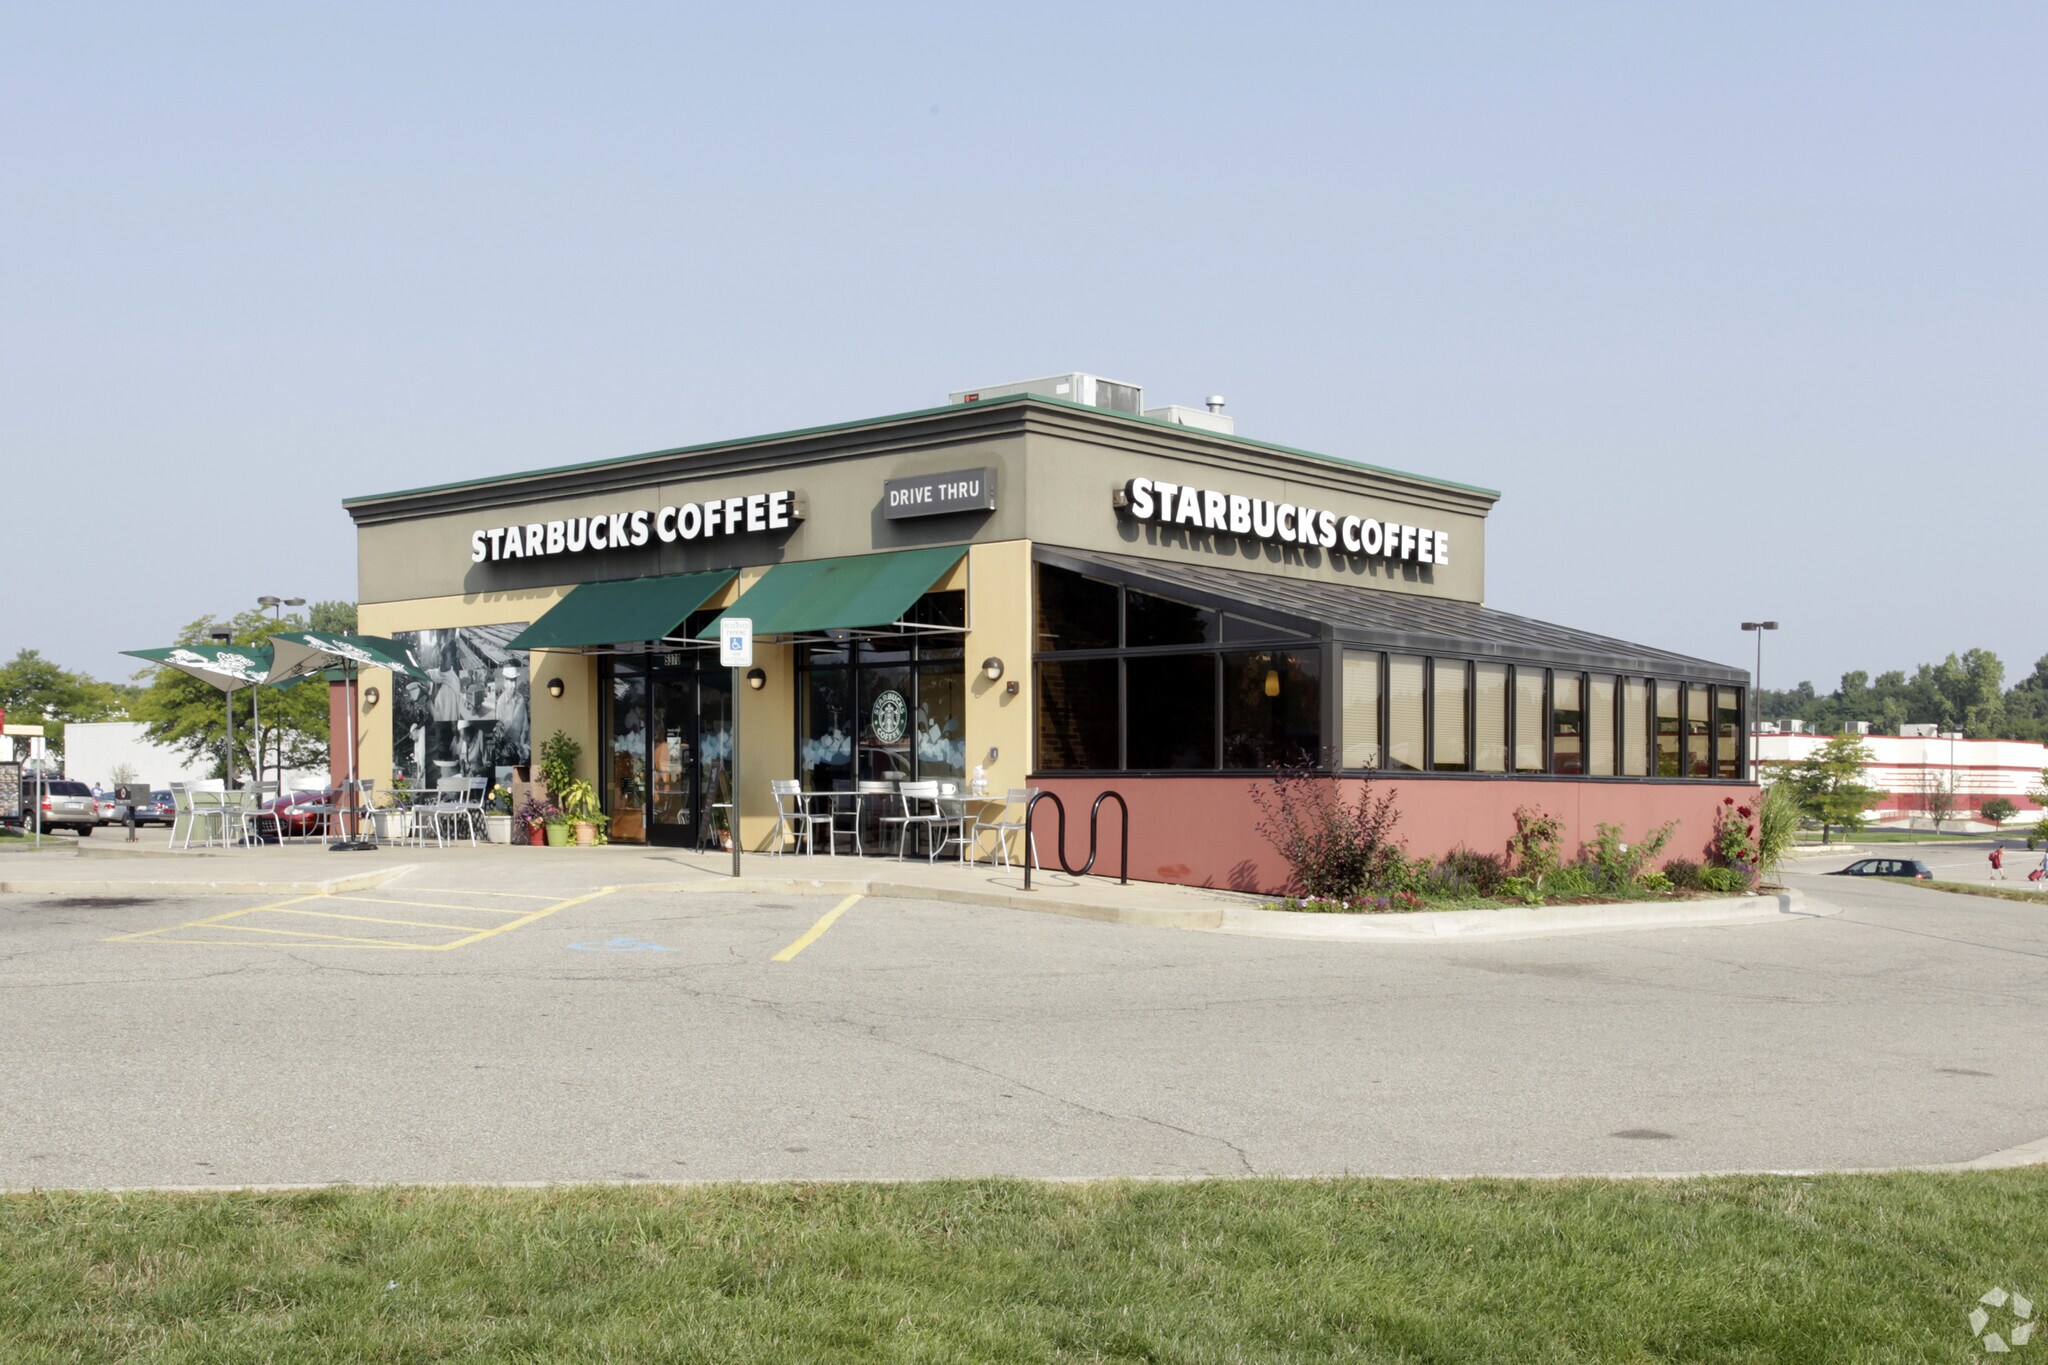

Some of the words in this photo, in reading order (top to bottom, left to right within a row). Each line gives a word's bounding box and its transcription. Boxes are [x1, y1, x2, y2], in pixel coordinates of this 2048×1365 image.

[890, 486, 933, 506] DRIVE
[938, 480, 979, 500] THRU
[471, 510, 650, 563] STARBUCKS
[656, 490, 789, 543] COFFEE
[1132, 477, 1337, 548] STARBUCKS
[1342, 515, 1449, 565] COFFEE
[873, 692, 905, 715] STARBUCKS
[877, 728, 901, 741] COFFEE
